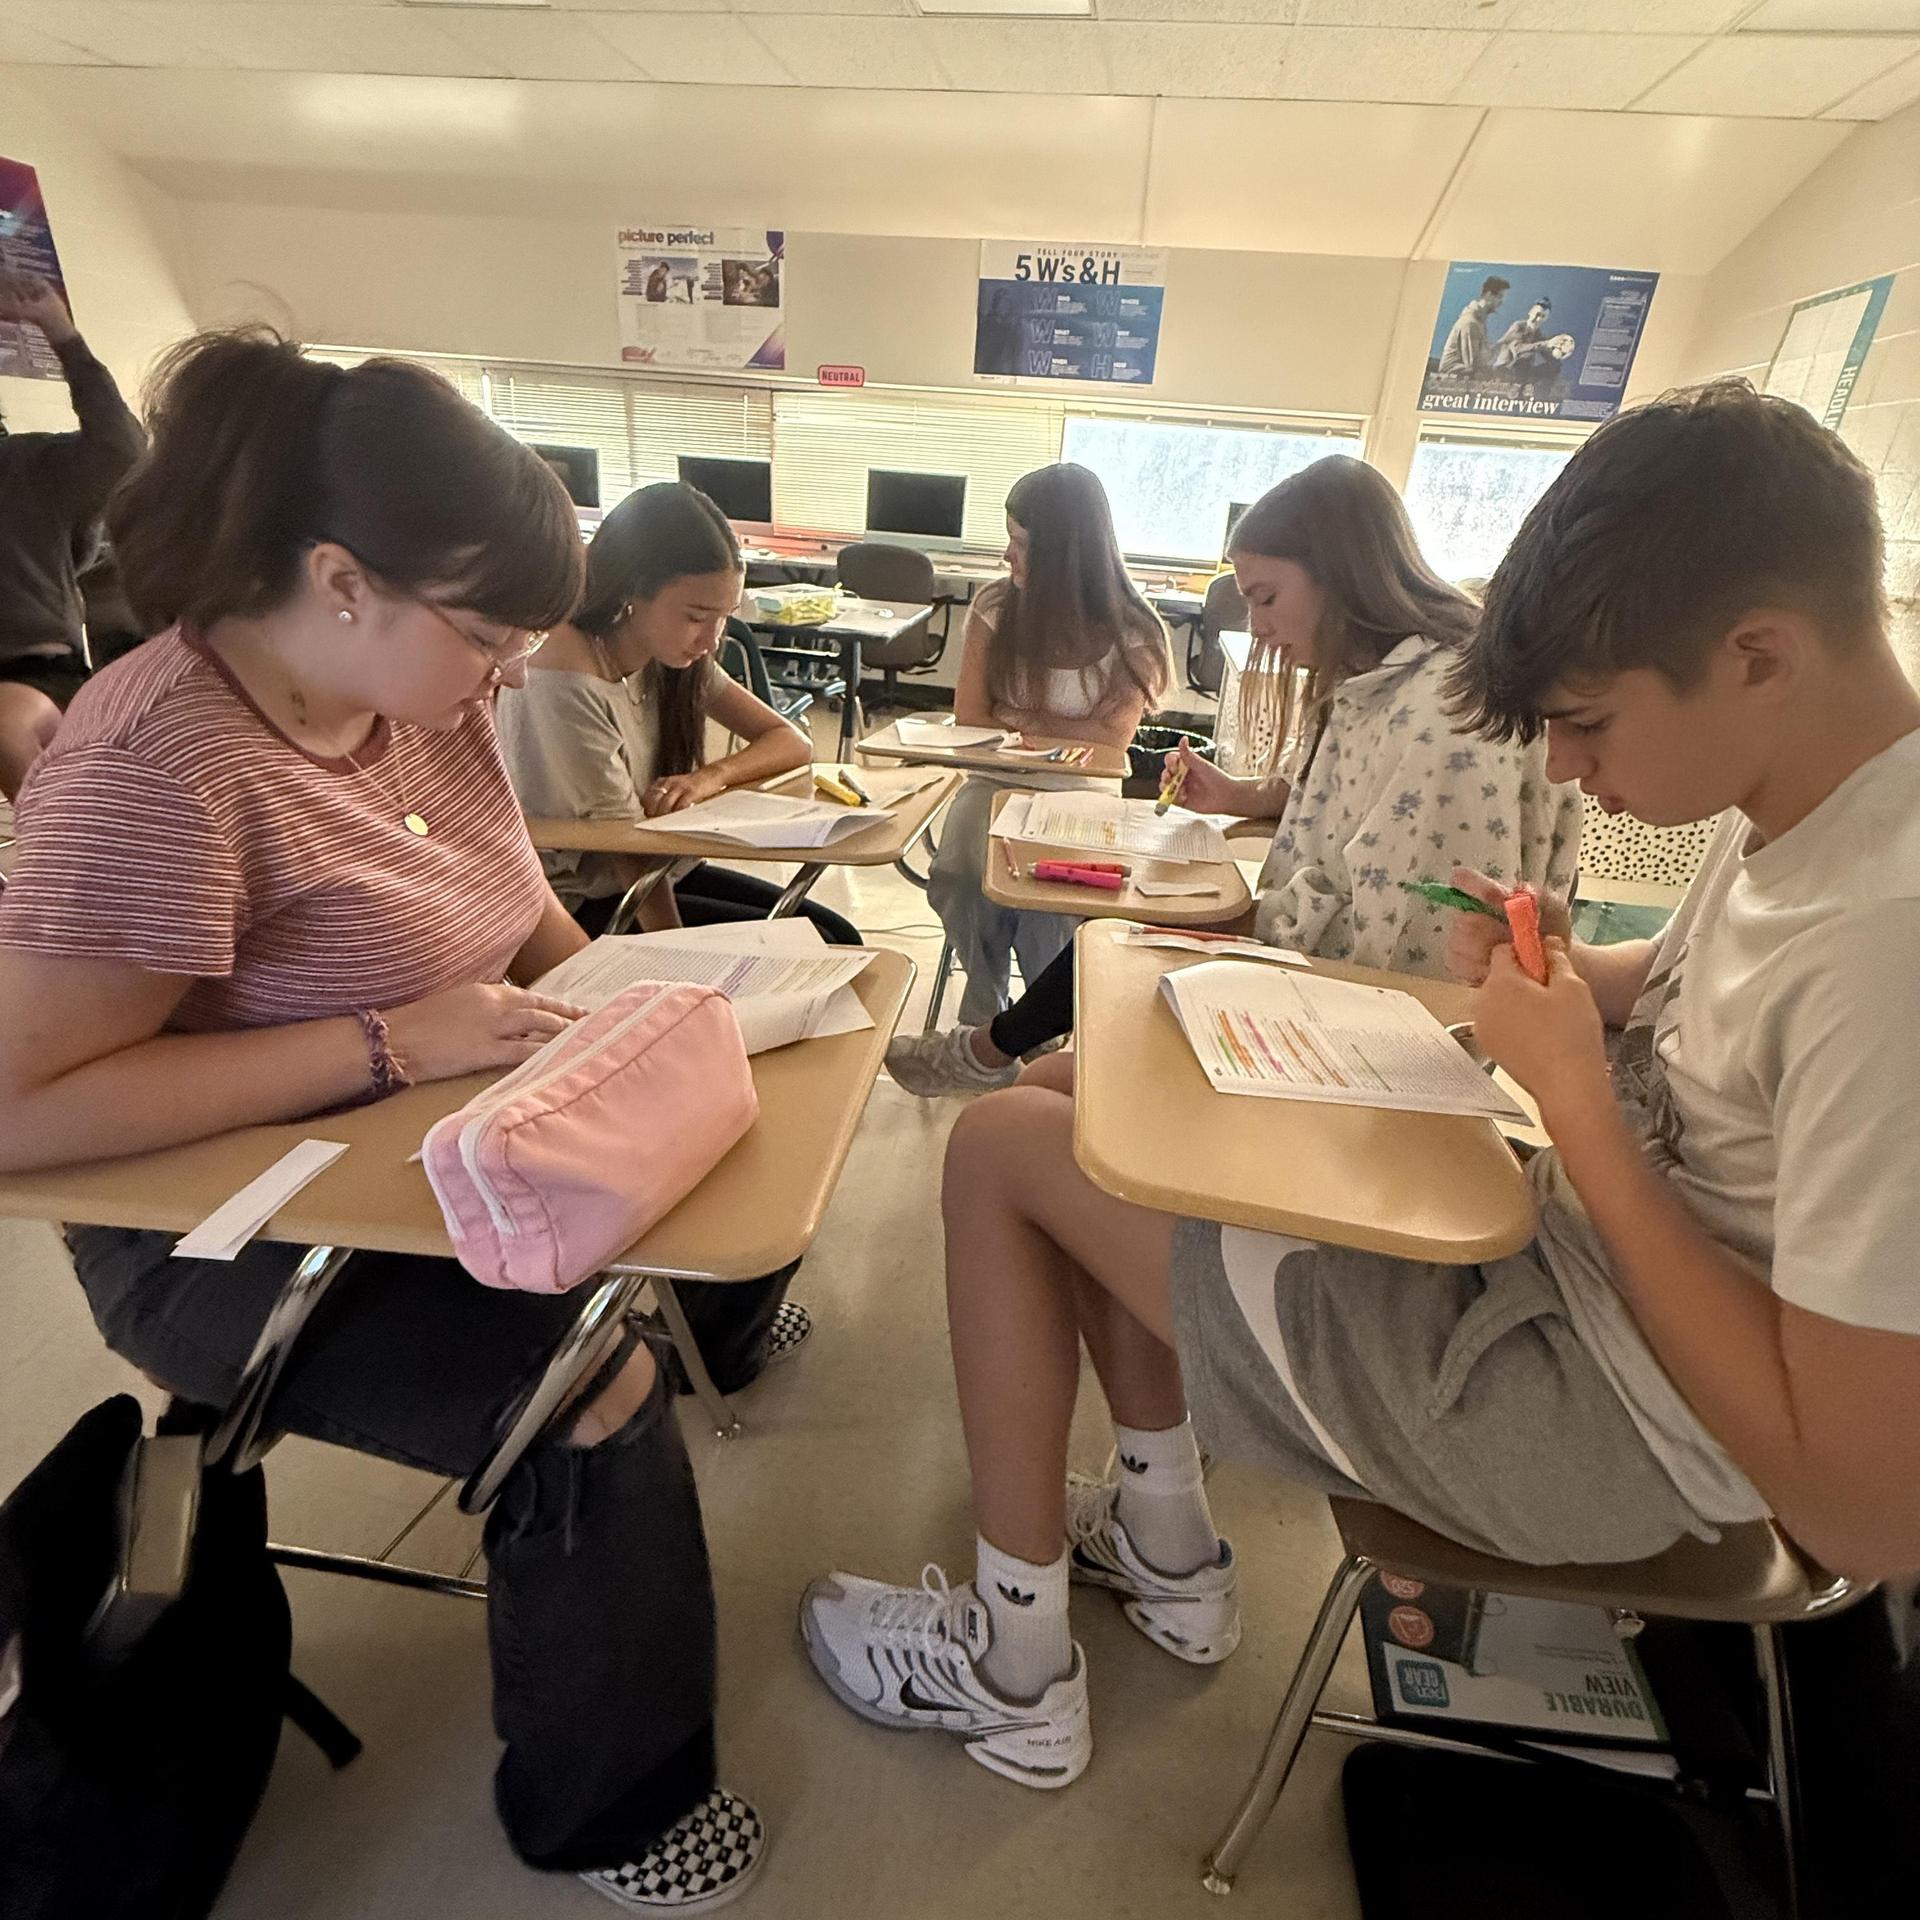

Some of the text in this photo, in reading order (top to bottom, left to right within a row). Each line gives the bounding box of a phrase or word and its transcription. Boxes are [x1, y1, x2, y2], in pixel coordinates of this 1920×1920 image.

[617, 228, 714, 246] picture perfect
[1037, 248, 1057, 256] TELL
[1062, 249, 1085, 257] YOUR
[1089, 250, 1118, 258] STORY
[822, 370, 860, 382] NEUTRAL
[1422, 393, 1470, 410] great
[1472, 393, 1559, 415] interview
[1404, 1667, 1439, 1688] GEAR
[1585, 1674, 1638, 1697] VIEW
[1546, 1693, 1644, 1720] DURABLE
